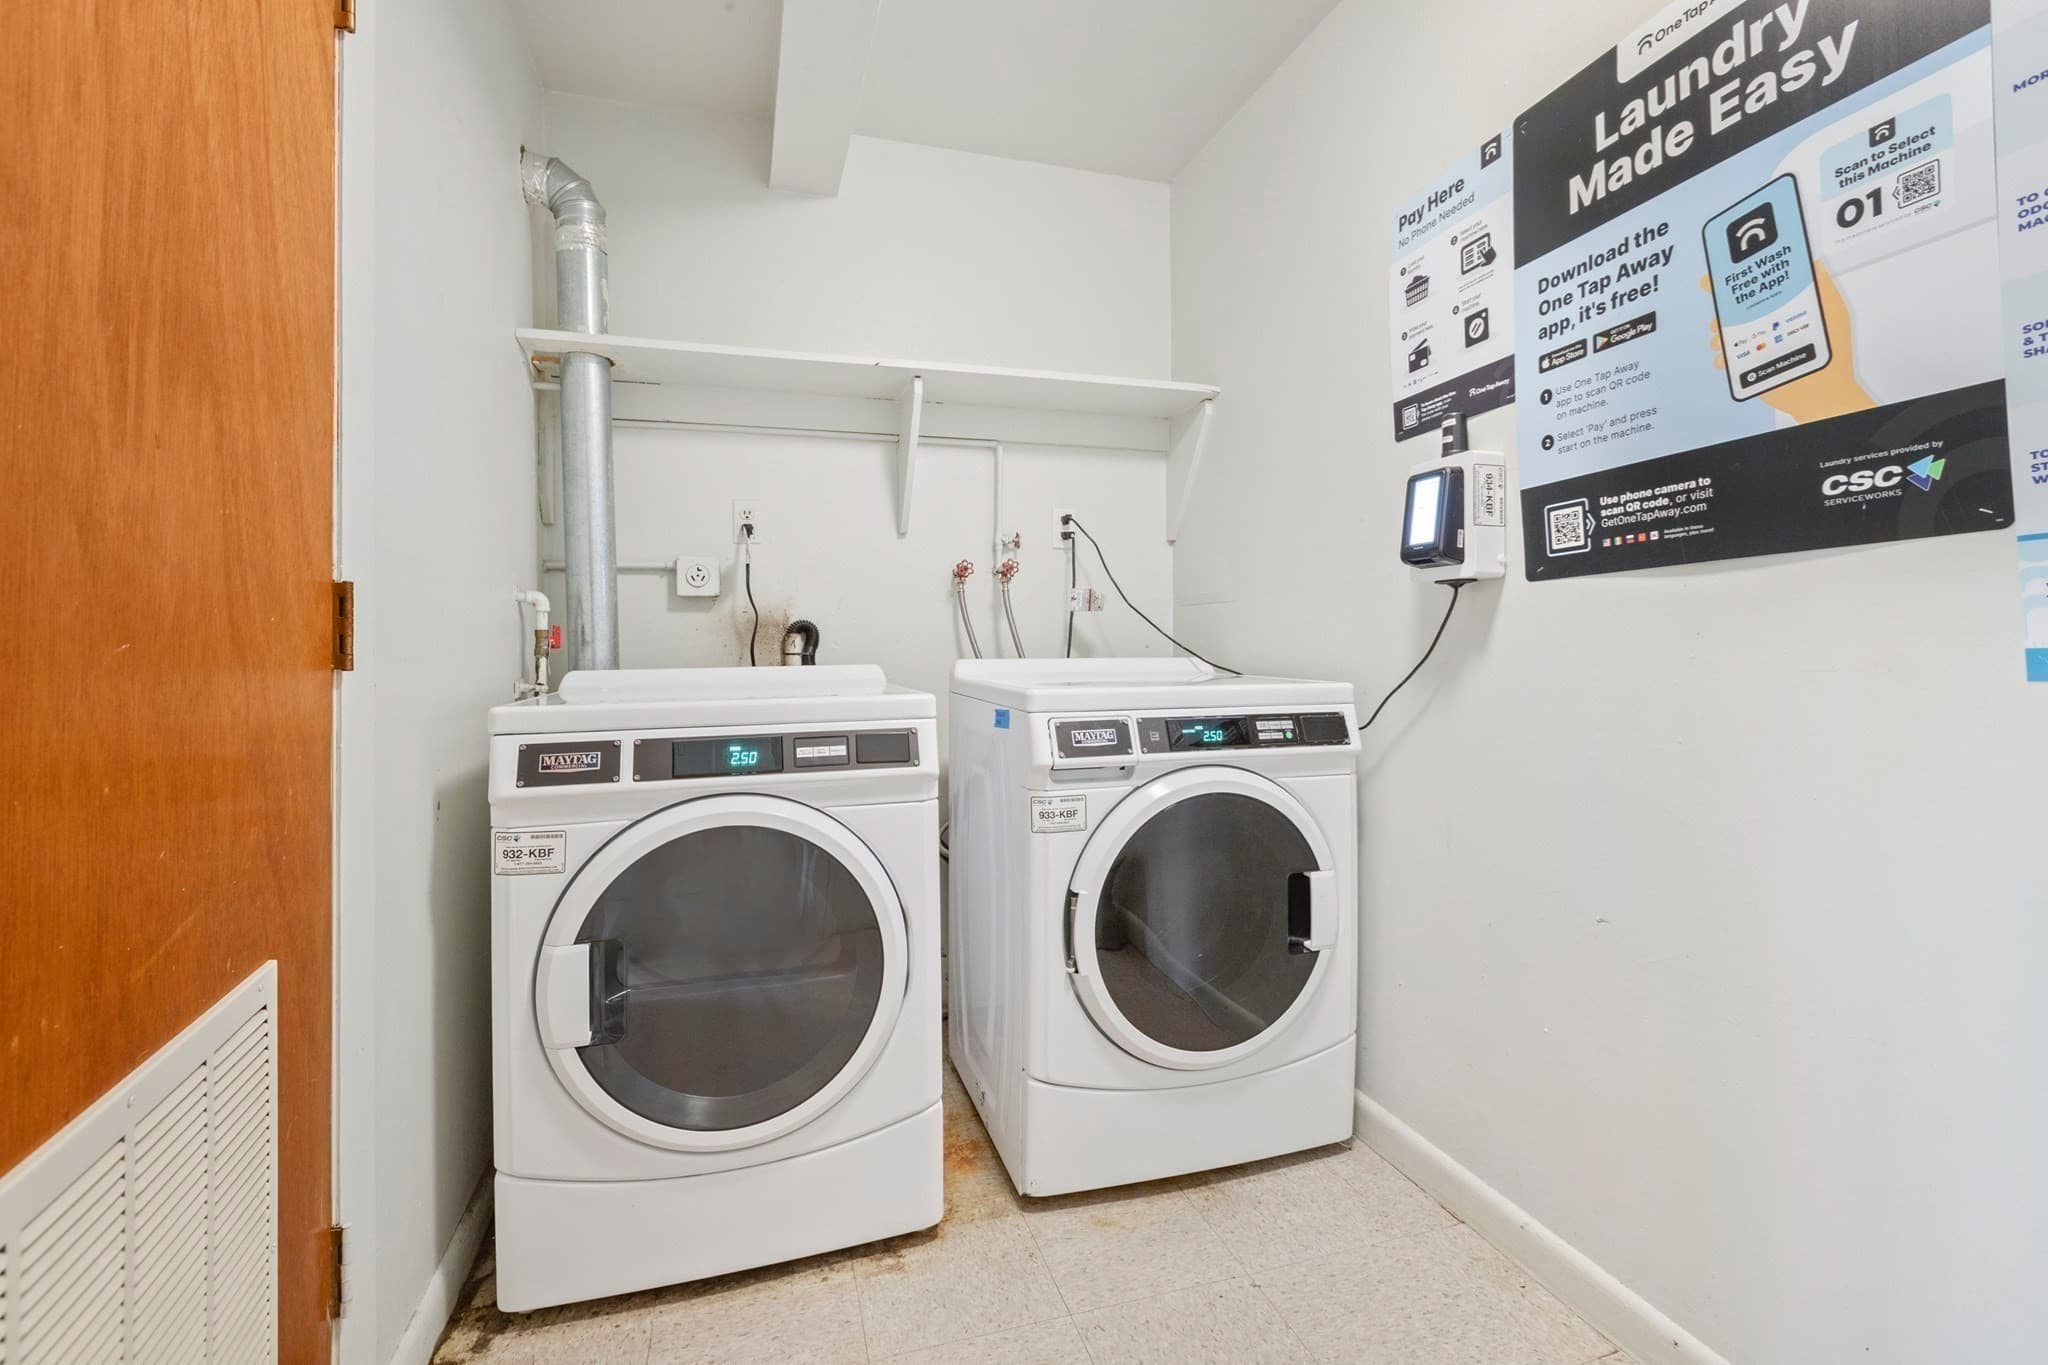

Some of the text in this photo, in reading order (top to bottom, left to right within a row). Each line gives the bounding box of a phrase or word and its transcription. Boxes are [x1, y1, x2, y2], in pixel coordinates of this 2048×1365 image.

[1595, 0, 1808, 153] Laundry
[1569, 19, 1859, 215] Made Easy
[1835, 126, 1936, 177] Scan to Select
[1839, 143, 1932, 188] this Machine
[1398, 204, 1425, 233] Pay
[1428, 178, 1465, 212] Here
[1836, 186, 1883, 229] 01
[2016, 193, 2039, 206] TO
[1398, 236, 1410, 249] No
[1411, 219, 1437, 241] Phone
[1439, 192, 1475, 222] Needed
[1538, 236, 1629, 295] Download
[1634, 222, 1669, 248] the
[1725, 244, 1792, 286] First Wash
[1538, 245, 1674, 316] One Tap Away
[1731, 259, 1790, 294] Free with
[1736, 290, 1756, 305] the
[1759, 271, 1789, 293] App!
[1538, 274, 1659, 340] app, it's free!
[1609, 328, 1636, 343] Google
[1636, 322, 1653, 334] Play
[2024, 336, 2034, 346] &
[1551, 355, 1566, 366] App
[1566, 349, 1585, 360] Store
[1758, 353, 1808, 377] Scan Machine
[1555, 384, 1572, 395] Use
[1574, 377, 1592, 389] One
[1595, 370, 1611, 382] Tap
[1614, 360, 1640, 375] Away
[1556, 370, 1651, 409] app to scan QR code
[1556, 399, 1609, 421] on machine.
[1557, 426, 1585, 442] Select
[1609, 415, 1627, 427] and
[1629, 406, 1657, 422] press
[1558, 422, 1655, 455] start on the machine.
[1820, 440, 1944, 468] Laundry services provided by
[1600, 477, 1711, 506] Use phone camera to
[1821, 465, 1903, 496] CSC
[1600, 487, 1714, 517] scan QR code, or visit
[1824, 488, 1902, 506] SERVICEWORKS
[1601, 502, 1707, 528] GetOneTapAway.com
[1074, 731, 1113, 741] MAYTAG
[543, 754, 597, 766] MAYTAG
[730, 751, 758, 765] 2.50
[1038, 809, 1078, 820] 933-KBF
[502, 848, 555, 859] 932-KBF
